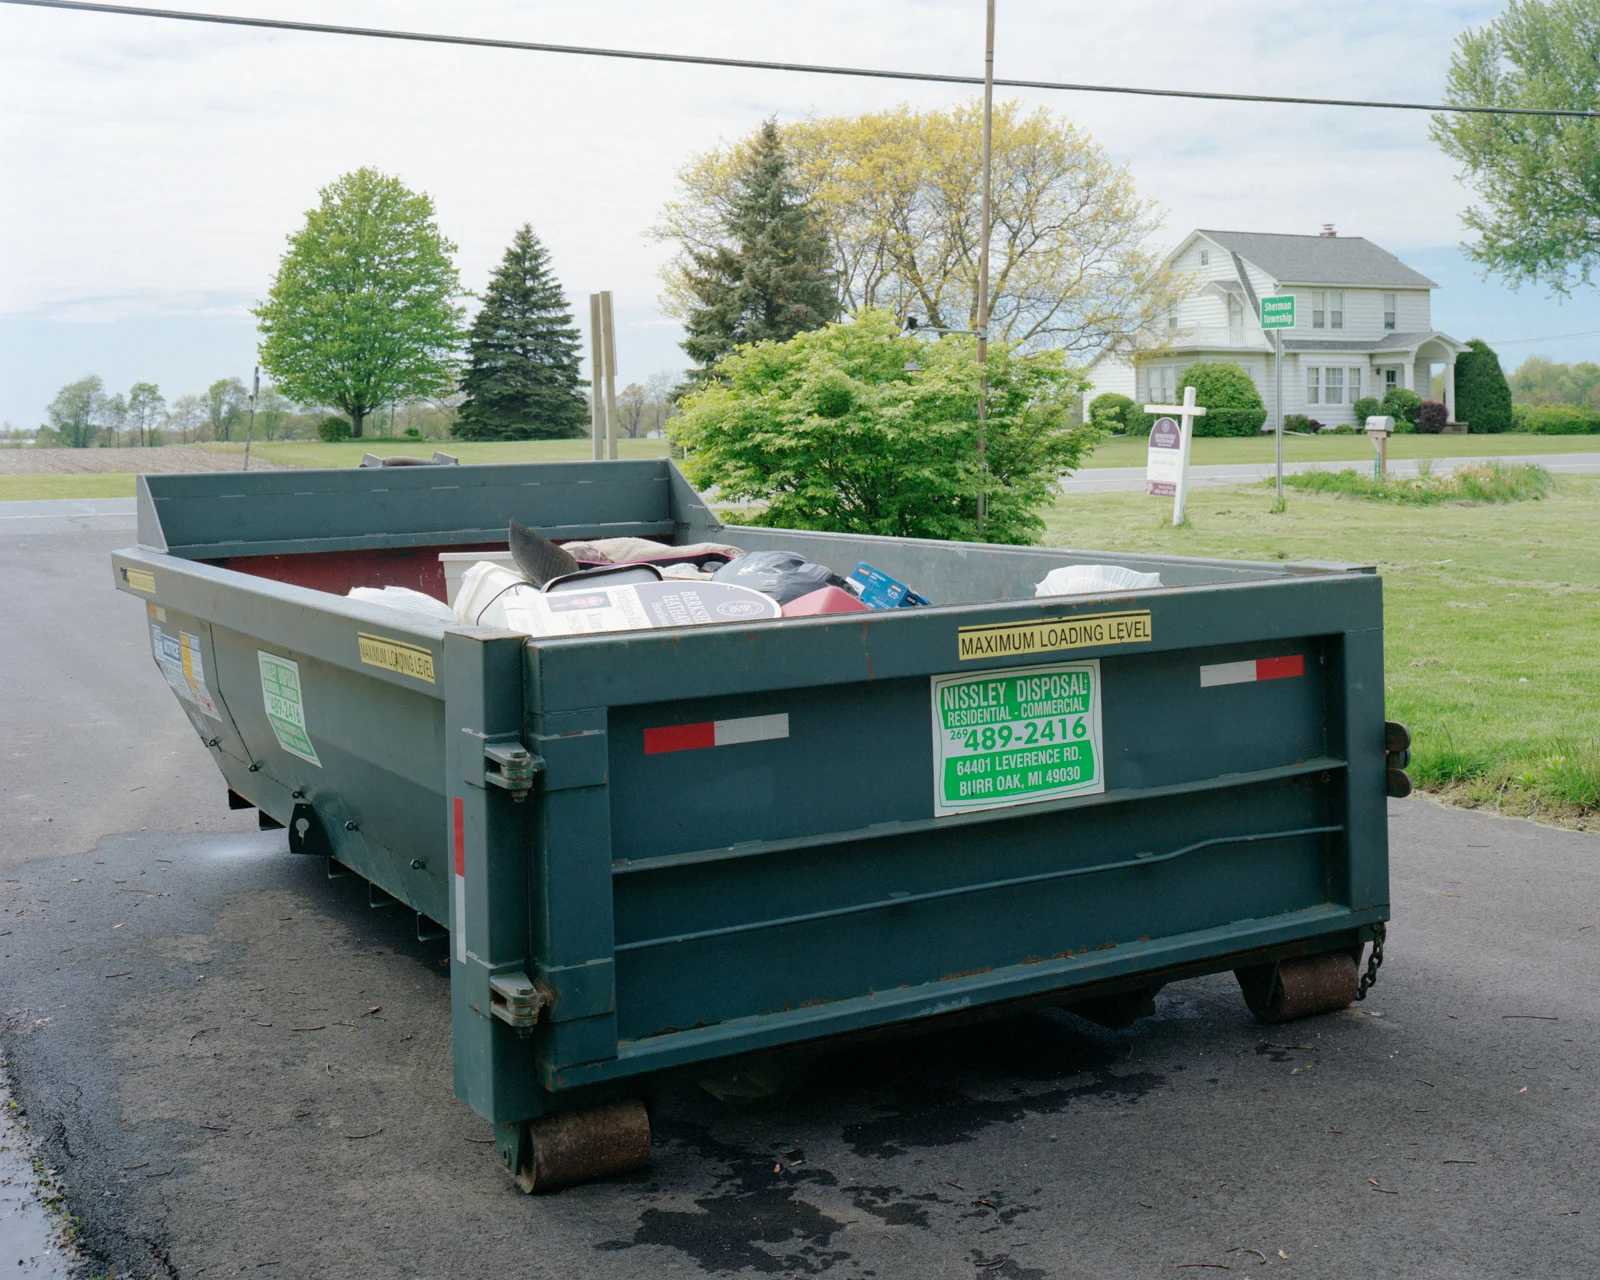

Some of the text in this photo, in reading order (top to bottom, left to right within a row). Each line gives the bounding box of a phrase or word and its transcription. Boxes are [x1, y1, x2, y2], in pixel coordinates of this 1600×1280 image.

[1263, 313, 1292, 324] Township
[1264, 302, 1292, 311] Sherman
[961, 621, 1150, 656] MAXIMUM LOADING LEVEL
[360, 642, 435, 680] MAXIMUM LOADING LEVEL
[943, 682, 1007, 710] NISSLEY
[1016, 673, 1088, 702] DISPOSAL
[947, 706, 1012, 726] RESIDENTIAL
[1021, 697, 1085, 718] COMMERCIAL
[950, 716, 1087, 751] 269 489-2416
[956, 746, 1082, 776] 64401 LEVERENCE RD.
[959, 766, 1081, 796] BURR OAK, MI 49030
